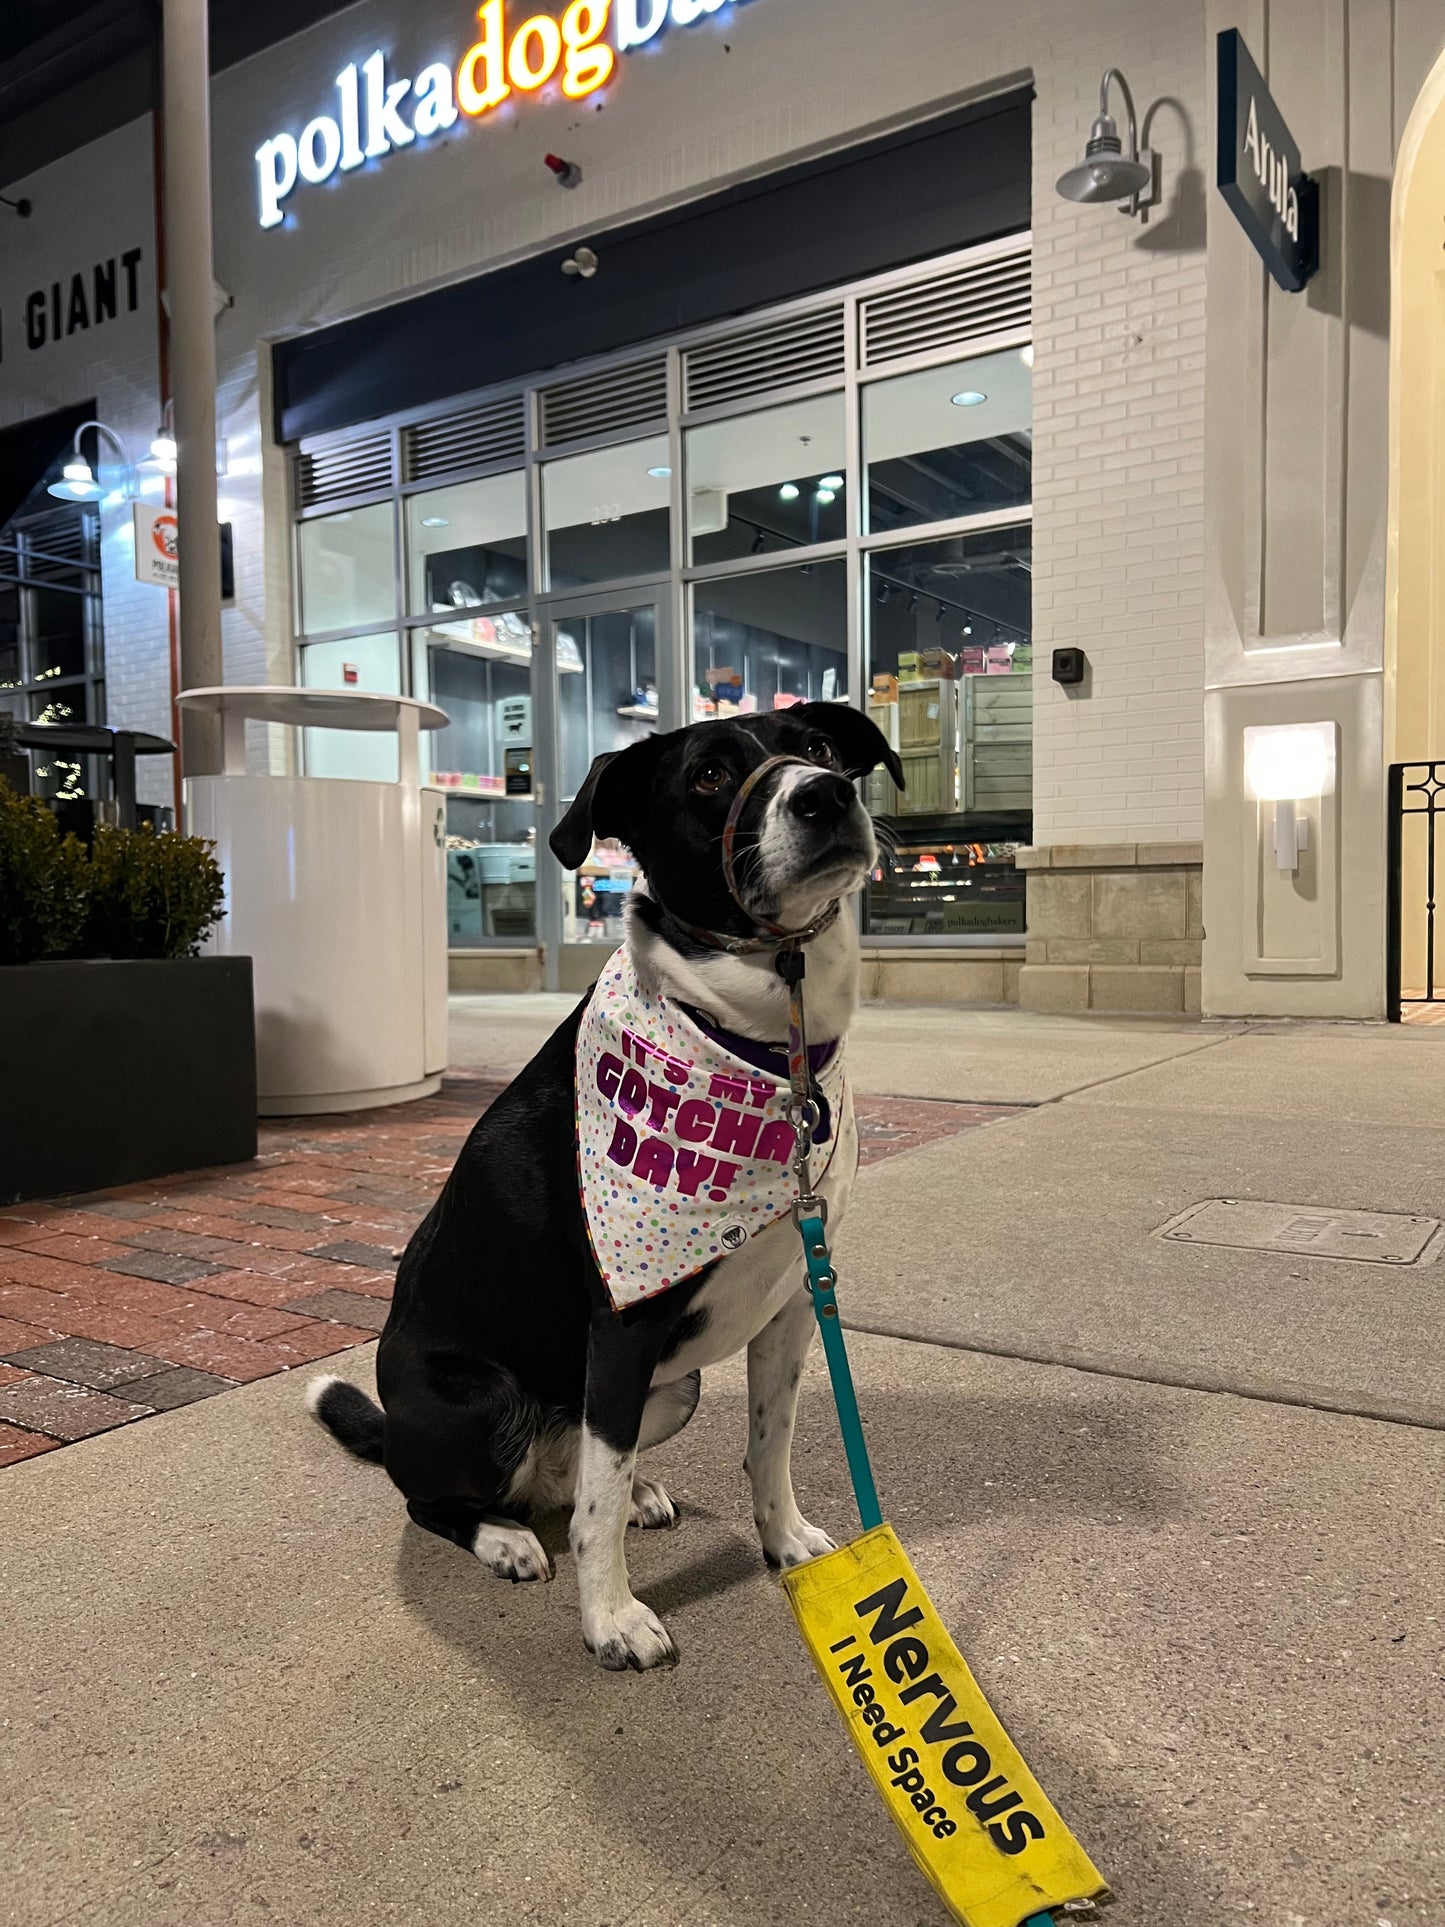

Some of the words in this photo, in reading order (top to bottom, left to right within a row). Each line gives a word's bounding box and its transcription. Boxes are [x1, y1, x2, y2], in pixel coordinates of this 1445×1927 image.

[1244, 95, 1298, 243] Arula
[25, 247, 142, 350] GIANT
[596, 1052, 798, 1166] GOTCHA
[708, 1072, 777, 1110] MY
[606, 1114, 741, 1203] DAY!
[829, 1635, 857, 1654] I
[838, 1653, 906, 1748] Need
[853, 1577, 1046, 1856] Nervous
[887, 1746, 958, 1840] Space
